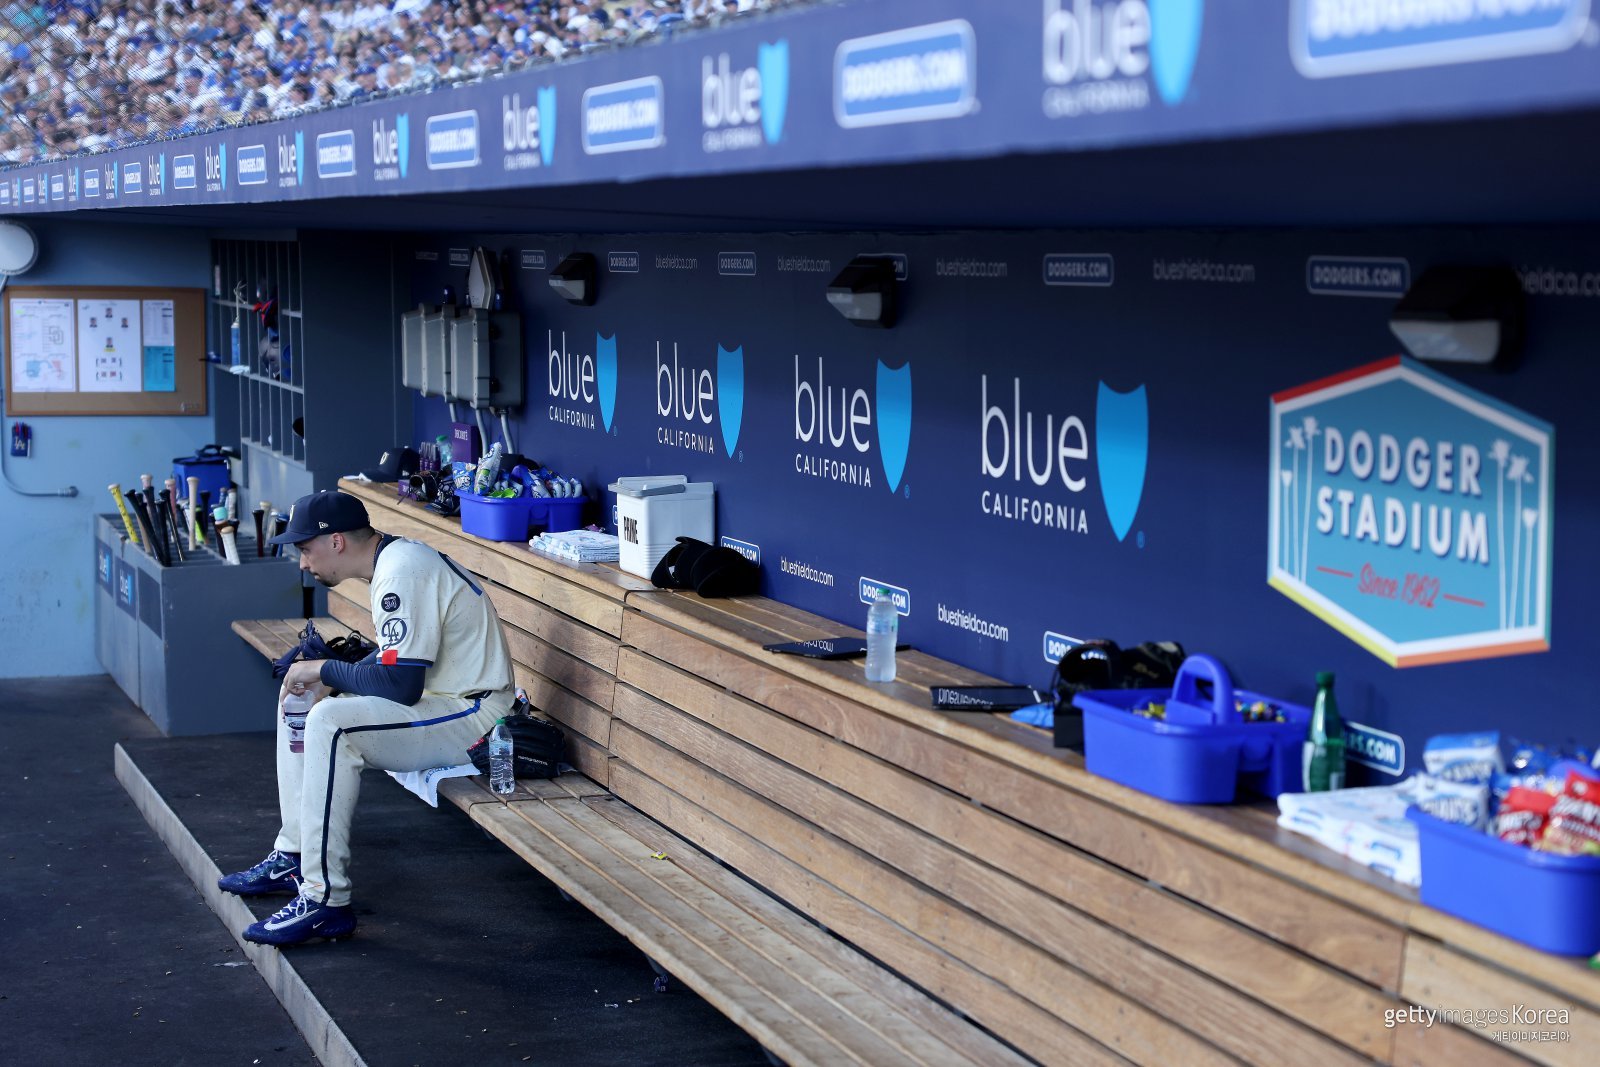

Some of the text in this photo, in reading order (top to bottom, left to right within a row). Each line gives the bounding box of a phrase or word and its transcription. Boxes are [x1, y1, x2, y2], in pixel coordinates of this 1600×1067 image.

[701, 52, 763, 128] blue
[503, 93, 541, 150] blue
[278, 134, 297, 174] blue
[373, 118, 399, 164] blue
[205, 145, 220, 180] blue
[610, 256, 638, 269] DODGERS.COM
[655, 253, 698, 270] blueshieldca.com
[720, 256, 754, 271] DODGERS.COM
[777, 255, 831, 273] blueshieldca.com
[936, 257, 1008, 278] blueshieldca.com
[1047, 261, 1109, 279] DODGERS.COM
[1152, 258, 1256, 283] blueshieldca.com
[1313, 264, 1402, 288] DODGERS.COM
[548, 328, 595, 403] blue
[656, 340, 714, 424] blue
[549, 405, 595, 430] CALIFORNIA
[795, 354, 871, 452] blue
[657, 427, 715, 454] CALIFORNIA
[981, 373, 1089, 493] blue
[795, 453, 872, 488] CALIFORNIA
[1323, 426, 1482, 496] DODGER
[981, 490, 1088, 535] CALIFORNIA
[1315, 485, 1490, 565] STADIUM
[780, 556, 834, 587] blueshieldca.com
[1357, 562, 1398, 600] Since
[937, 603, 1009, 643] blueshieldca.com
